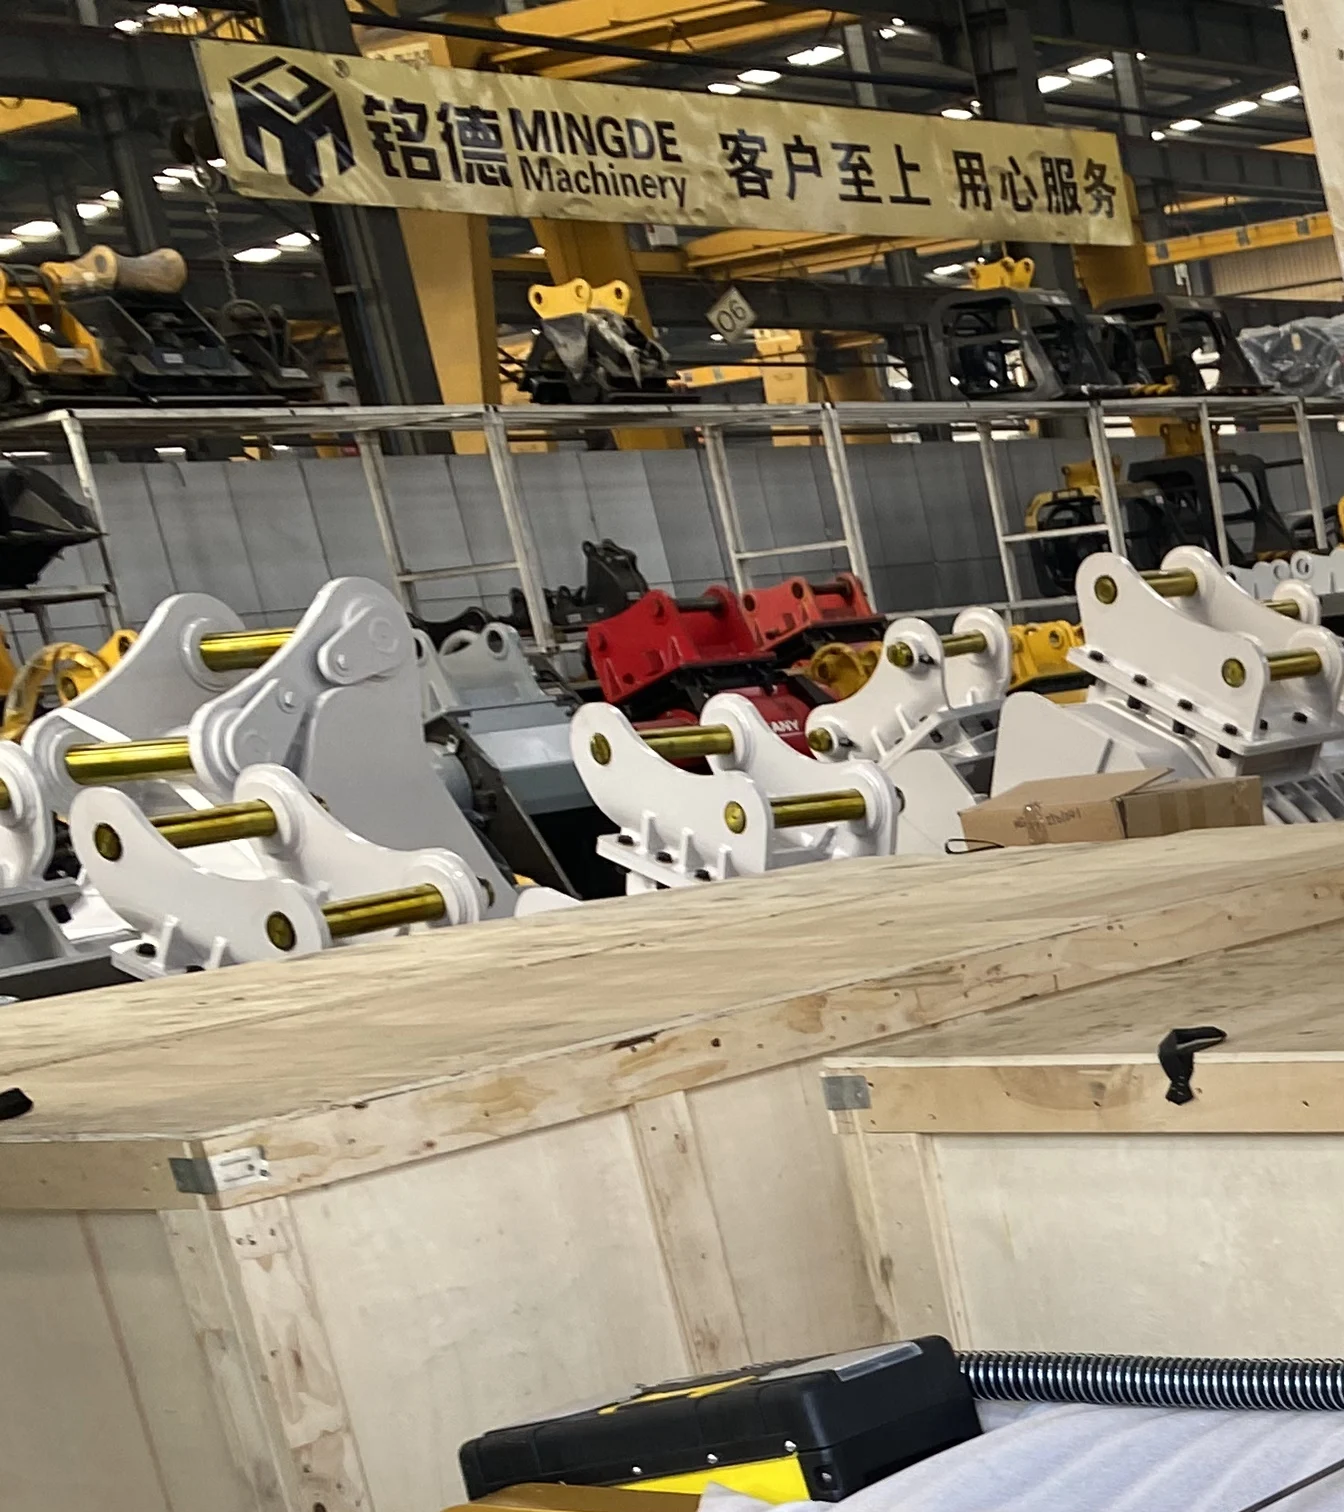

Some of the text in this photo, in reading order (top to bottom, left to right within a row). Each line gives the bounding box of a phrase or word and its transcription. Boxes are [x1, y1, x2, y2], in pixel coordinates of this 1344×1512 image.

[363, 94, 513, 187] 铭德
[508, 107, 683, 162] MINGDE
[518, 155, 686, 207] Machinery
[718, 128, 1116, 218] 客户至上 用心服务
[717, 300, 746, 332] 06
